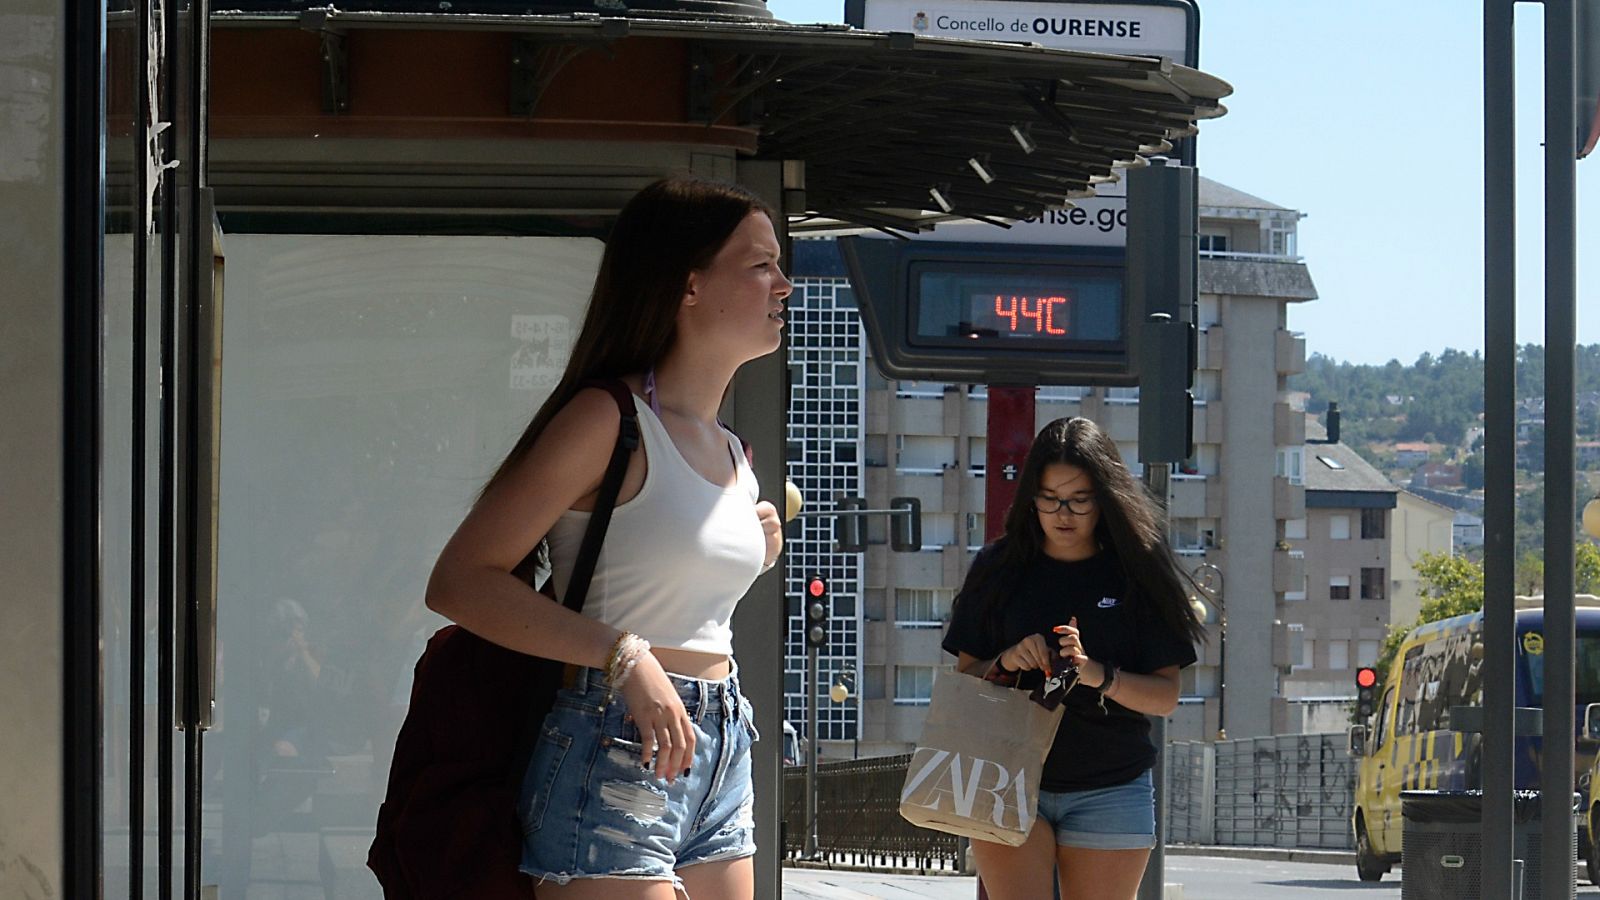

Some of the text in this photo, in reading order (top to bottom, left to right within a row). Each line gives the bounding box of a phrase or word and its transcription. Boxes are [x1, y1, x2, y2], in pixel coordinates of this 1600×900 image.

[937, 16, 1141, 38] Concello de OURENSE
[900, 747, 1029, 831] ZARA
